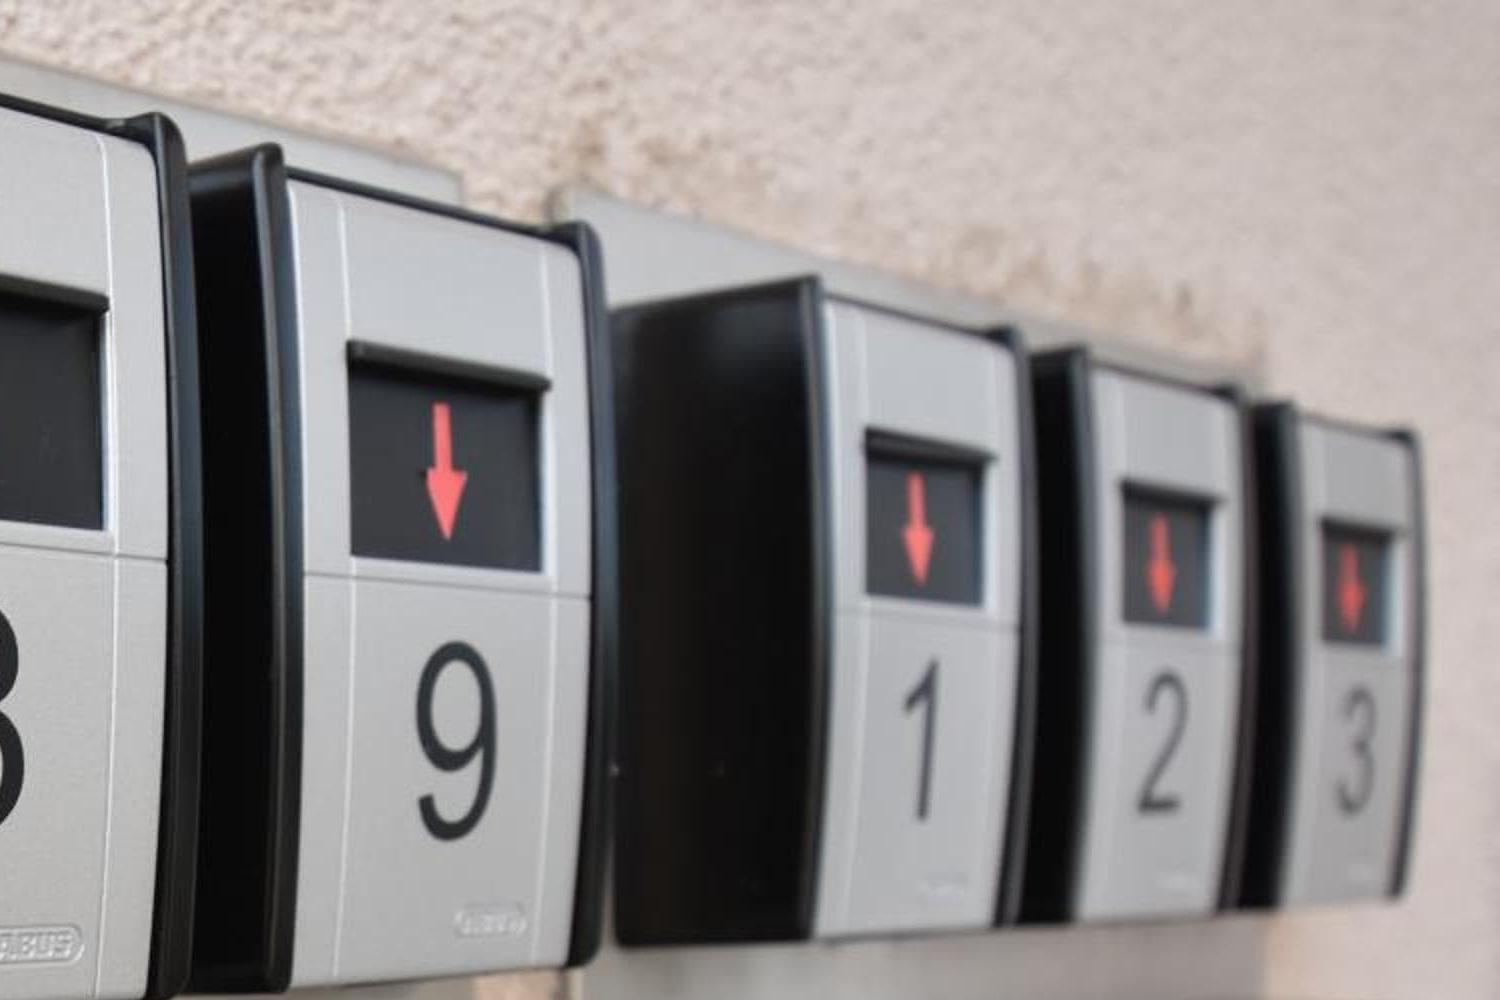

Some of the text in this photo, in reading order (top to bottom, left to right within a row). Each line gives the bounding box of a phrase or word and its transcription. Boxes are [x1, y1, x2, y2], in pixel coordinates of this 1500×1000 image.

[415, 641, 498, 842] 9
[902, 658, 940, 823] 1
[1133, 668, 1190, 819] 2
[1333, 683, 1379, 821] 3
